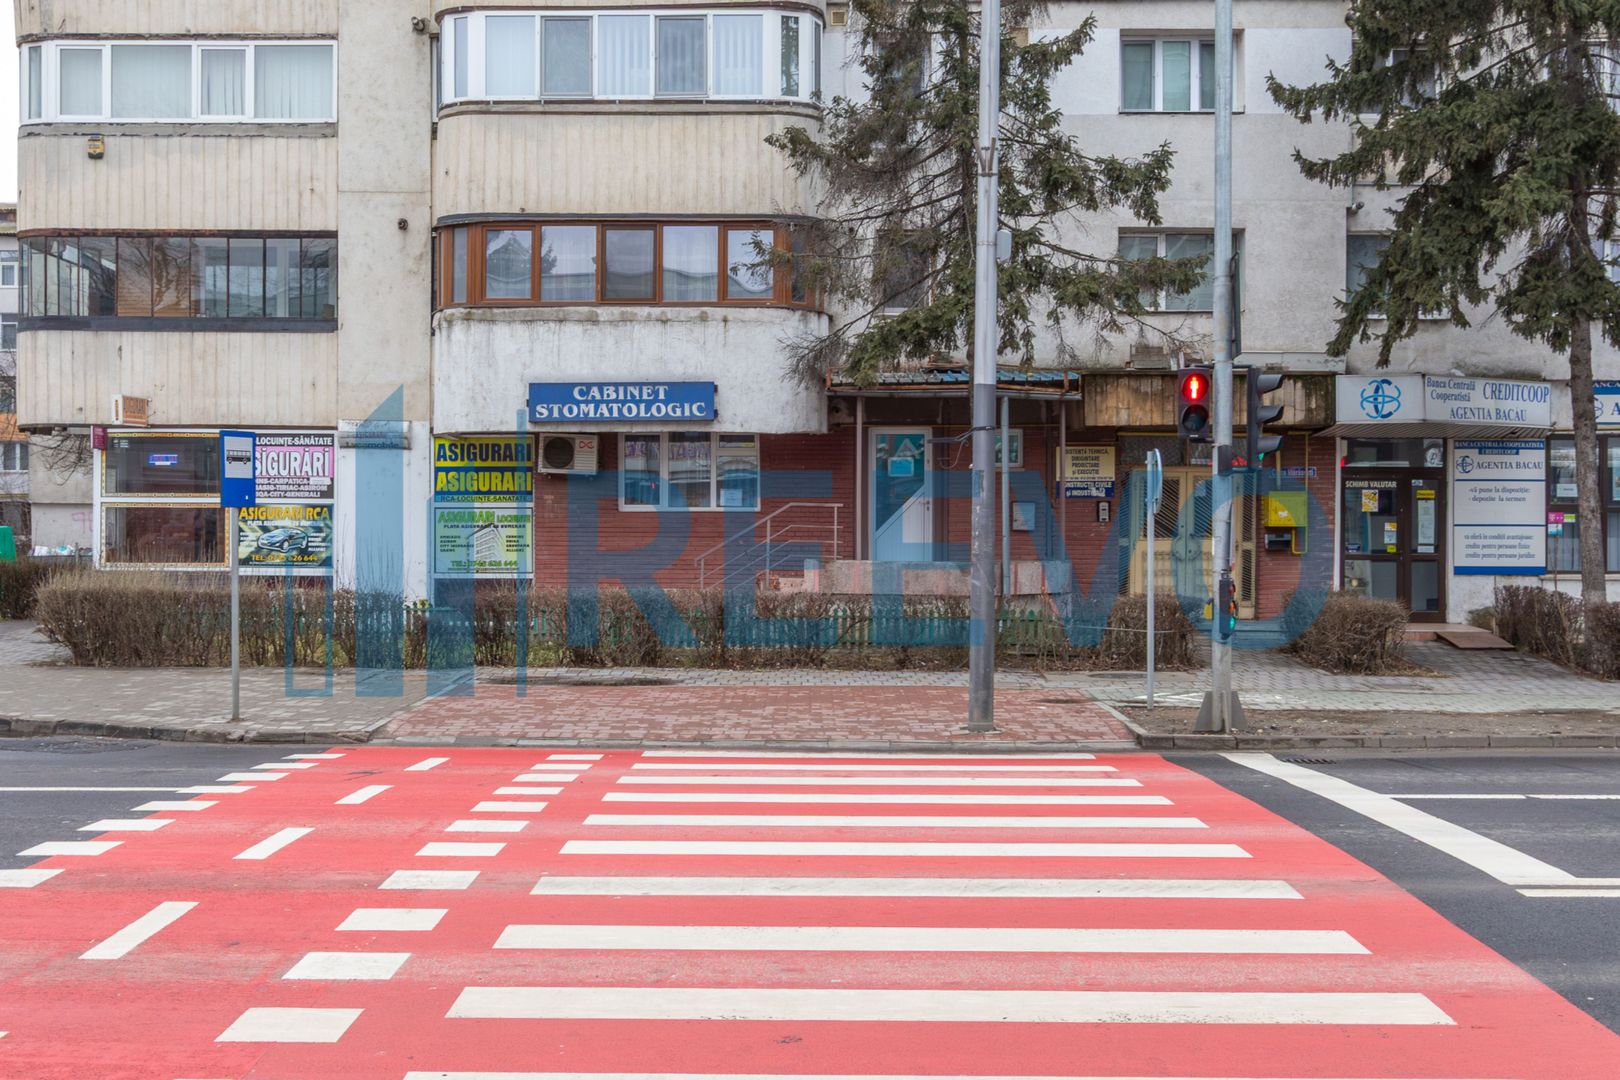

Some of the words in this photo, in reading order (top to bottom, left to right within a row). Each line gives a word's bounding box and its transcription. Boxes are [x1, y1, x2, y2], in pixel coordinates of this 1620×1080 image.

[1427, 377, 1446, 389] Banca
[573, 385, 669, 400] CABINET
[1483, 382, 1550, 403] CREDITCOOP
[536, 402, 706, 418] STOMATOLOGIC
[437, 442, 532, 462] ASIGURARI
[436, 470, 532, 492] ASIGURARI
[306, 507, 330, 520] RCA
